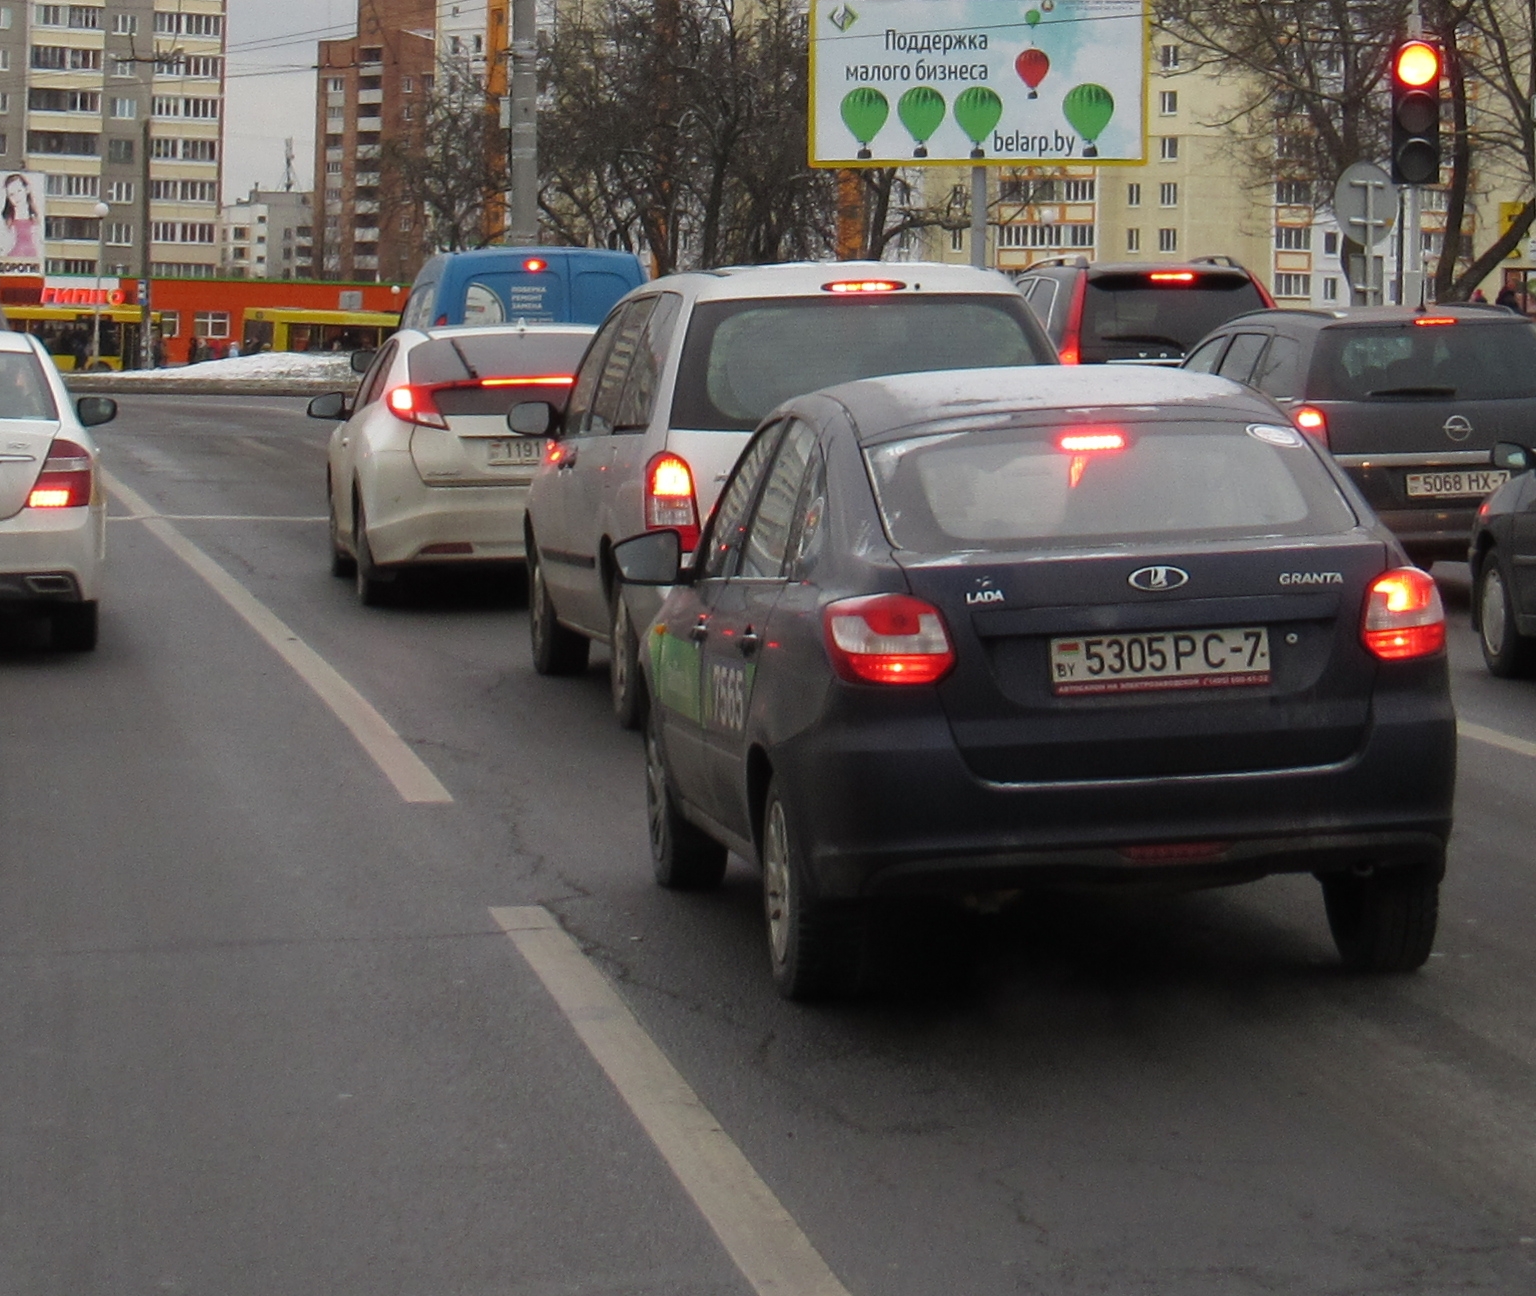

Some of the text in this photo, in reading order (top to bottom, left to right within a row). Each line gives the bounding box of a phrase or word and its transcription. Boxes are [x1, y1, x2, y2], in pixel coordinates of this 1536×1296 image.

[885, 29, 988, 54] Поддержка
[845, 59, 988, 81] малого бизнеса
[993, 130, 1075, 156] belarp.by
[505, 440, 541, 458] 1191
[1423, 472, 1508, 492] 5068 HX-7
[1278, 571, 1344, 585] GRANTA
[966, 589, 1005, 604] LADA
[1084, 631, 1263, 676] 5305 PC-7
[1056, 663, 1076, 678] BY
